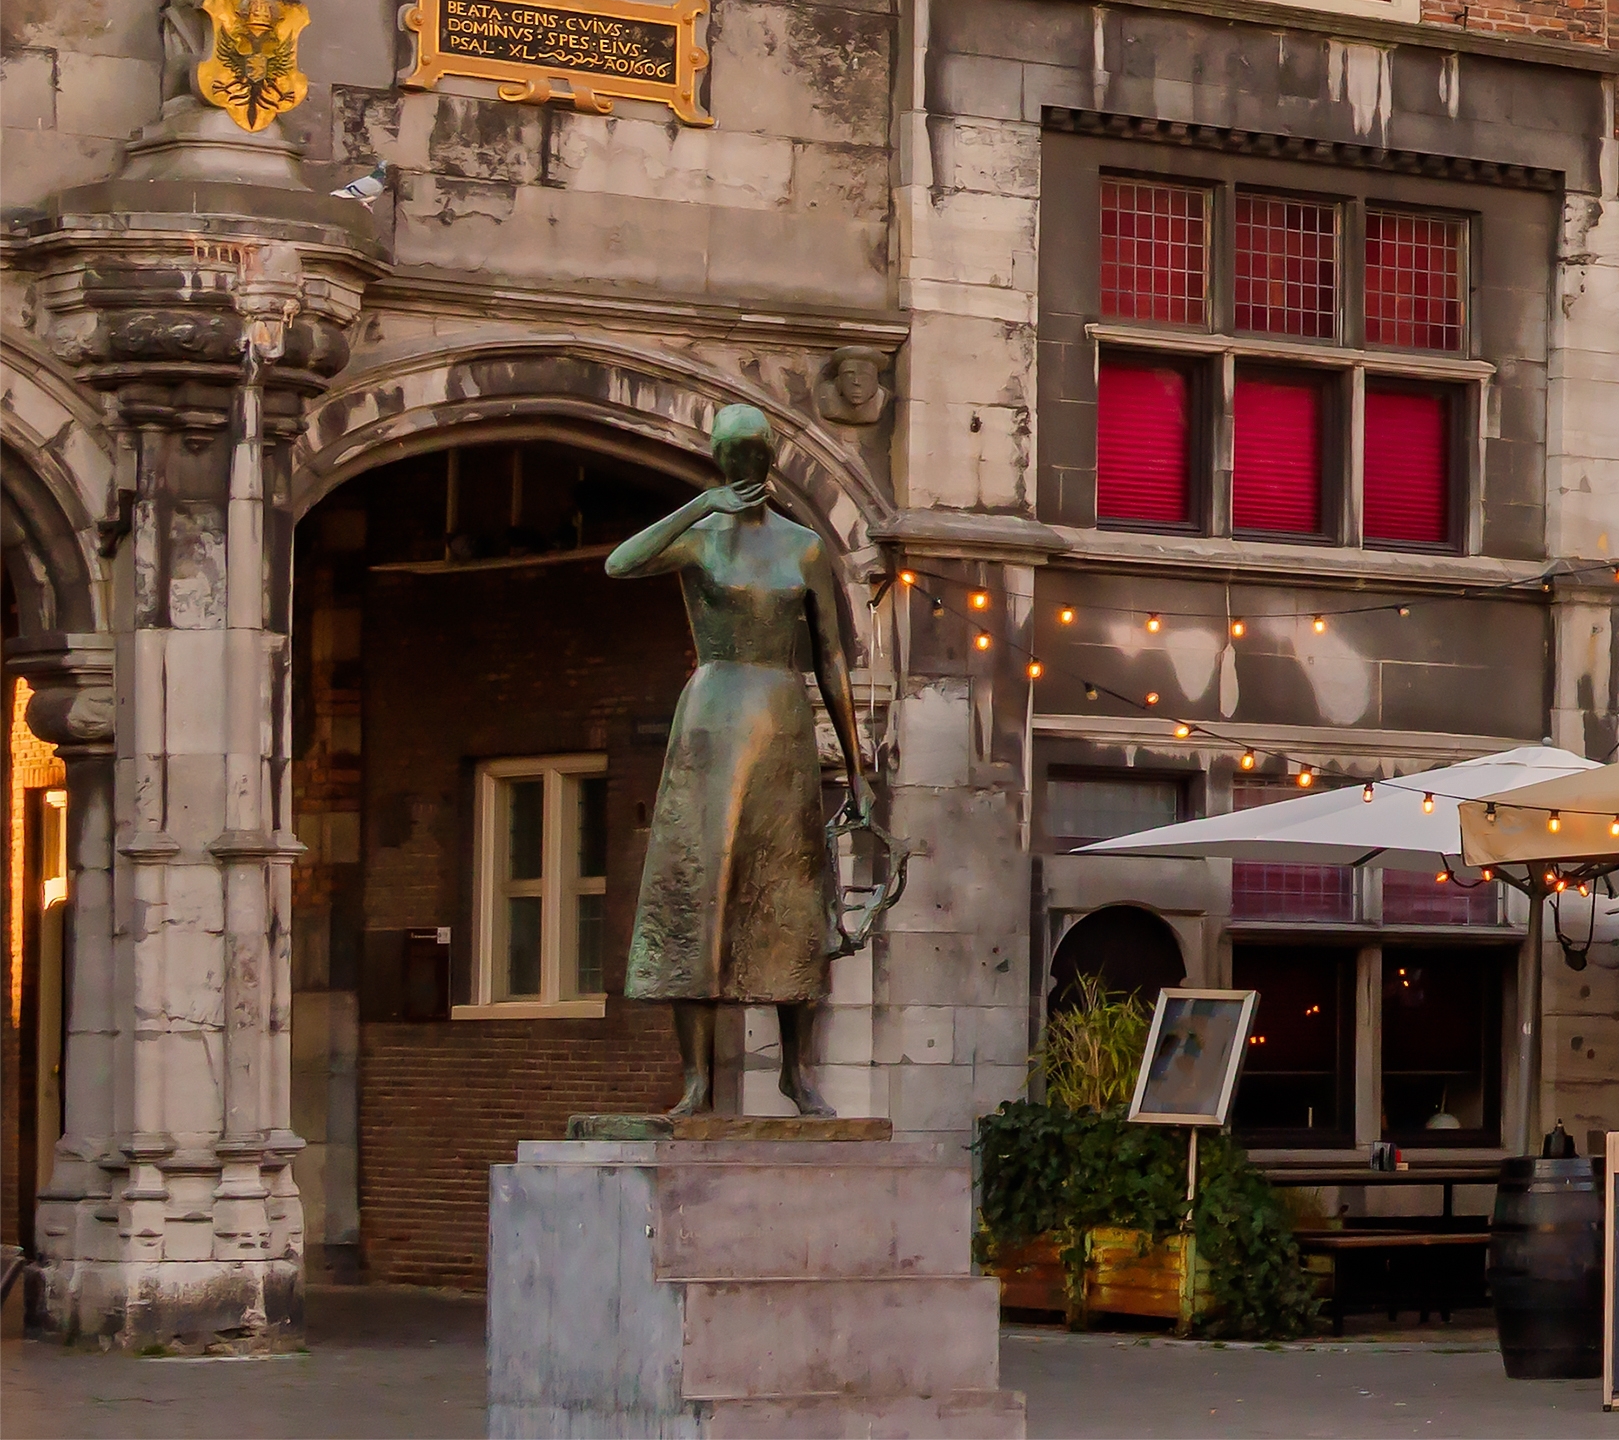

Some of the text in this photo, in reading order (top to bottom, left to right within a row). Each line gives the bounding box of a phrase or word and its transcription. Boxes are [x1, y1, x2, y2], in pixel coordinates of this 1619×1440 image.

[447, 1, 502, 20] BEATA
[511, 10, 558, 28] GENS
[450, 35, 495, 54] PSAL
[508, 43, 537, 60] XL
[545, 32, 589, 50] SPES
